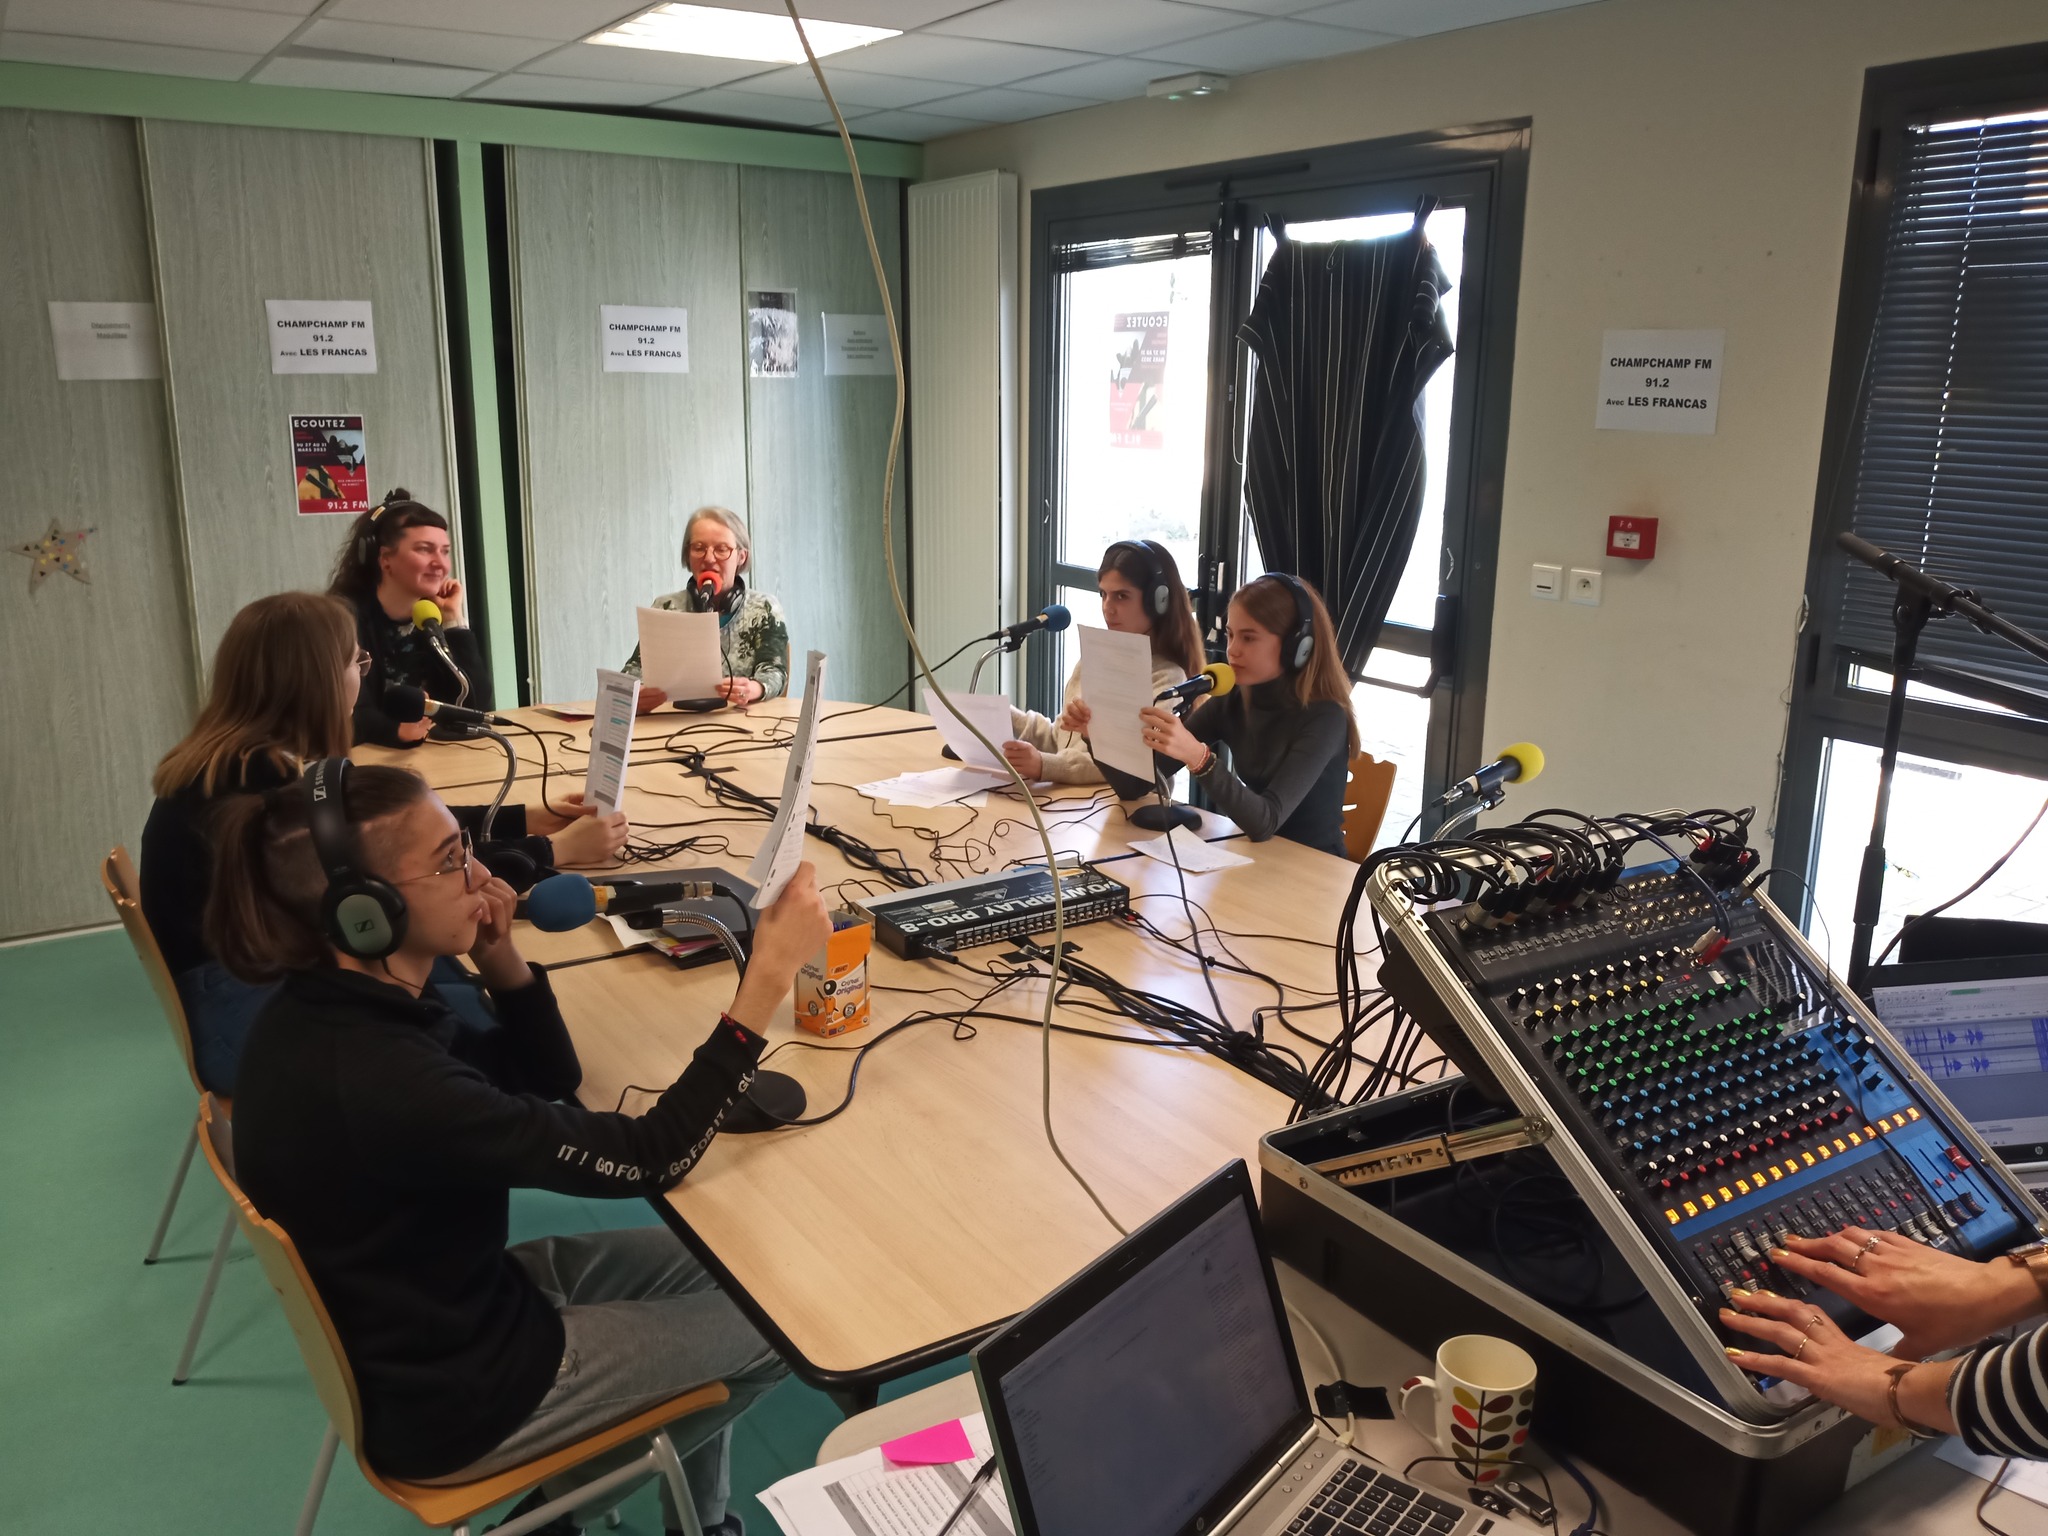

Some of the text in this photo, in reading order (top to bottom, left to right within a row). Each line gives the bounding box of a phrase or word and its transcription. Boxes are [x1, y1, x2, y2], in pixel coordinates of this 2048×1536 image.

[277, 320, 348, 328] CHAMPCHAMP
[609, 323, 667, 332] CHAMPCHAMP
[312, 334, 334, 342] 91.2
[300, 348, 319, 356] LES
[321, 348, 367, 356] FRANCAS
[627, 349, 642, 357] LES
[644, 350, 682, 358] FRANCAS
[1610, 357, 1712, 369] CHAMPCHAMP FM
[1645, 378, 1669, 387] 91.2
[1628, 397, 1649, 406] LES
[1652, 397, 1707, 409] FRANCAS
[294, 419, 346, 428] ECOUTEZ
[327, 500, 369, 510] 91.2 FM
[900, 910, 980, 933] PRO-8
[557, 1144, 578, 1161] IT
[595, 1156, 614, 1177] GO
[669, 1158, 691, 1177] GO
[689, 1127, 715, 1160] FOR
